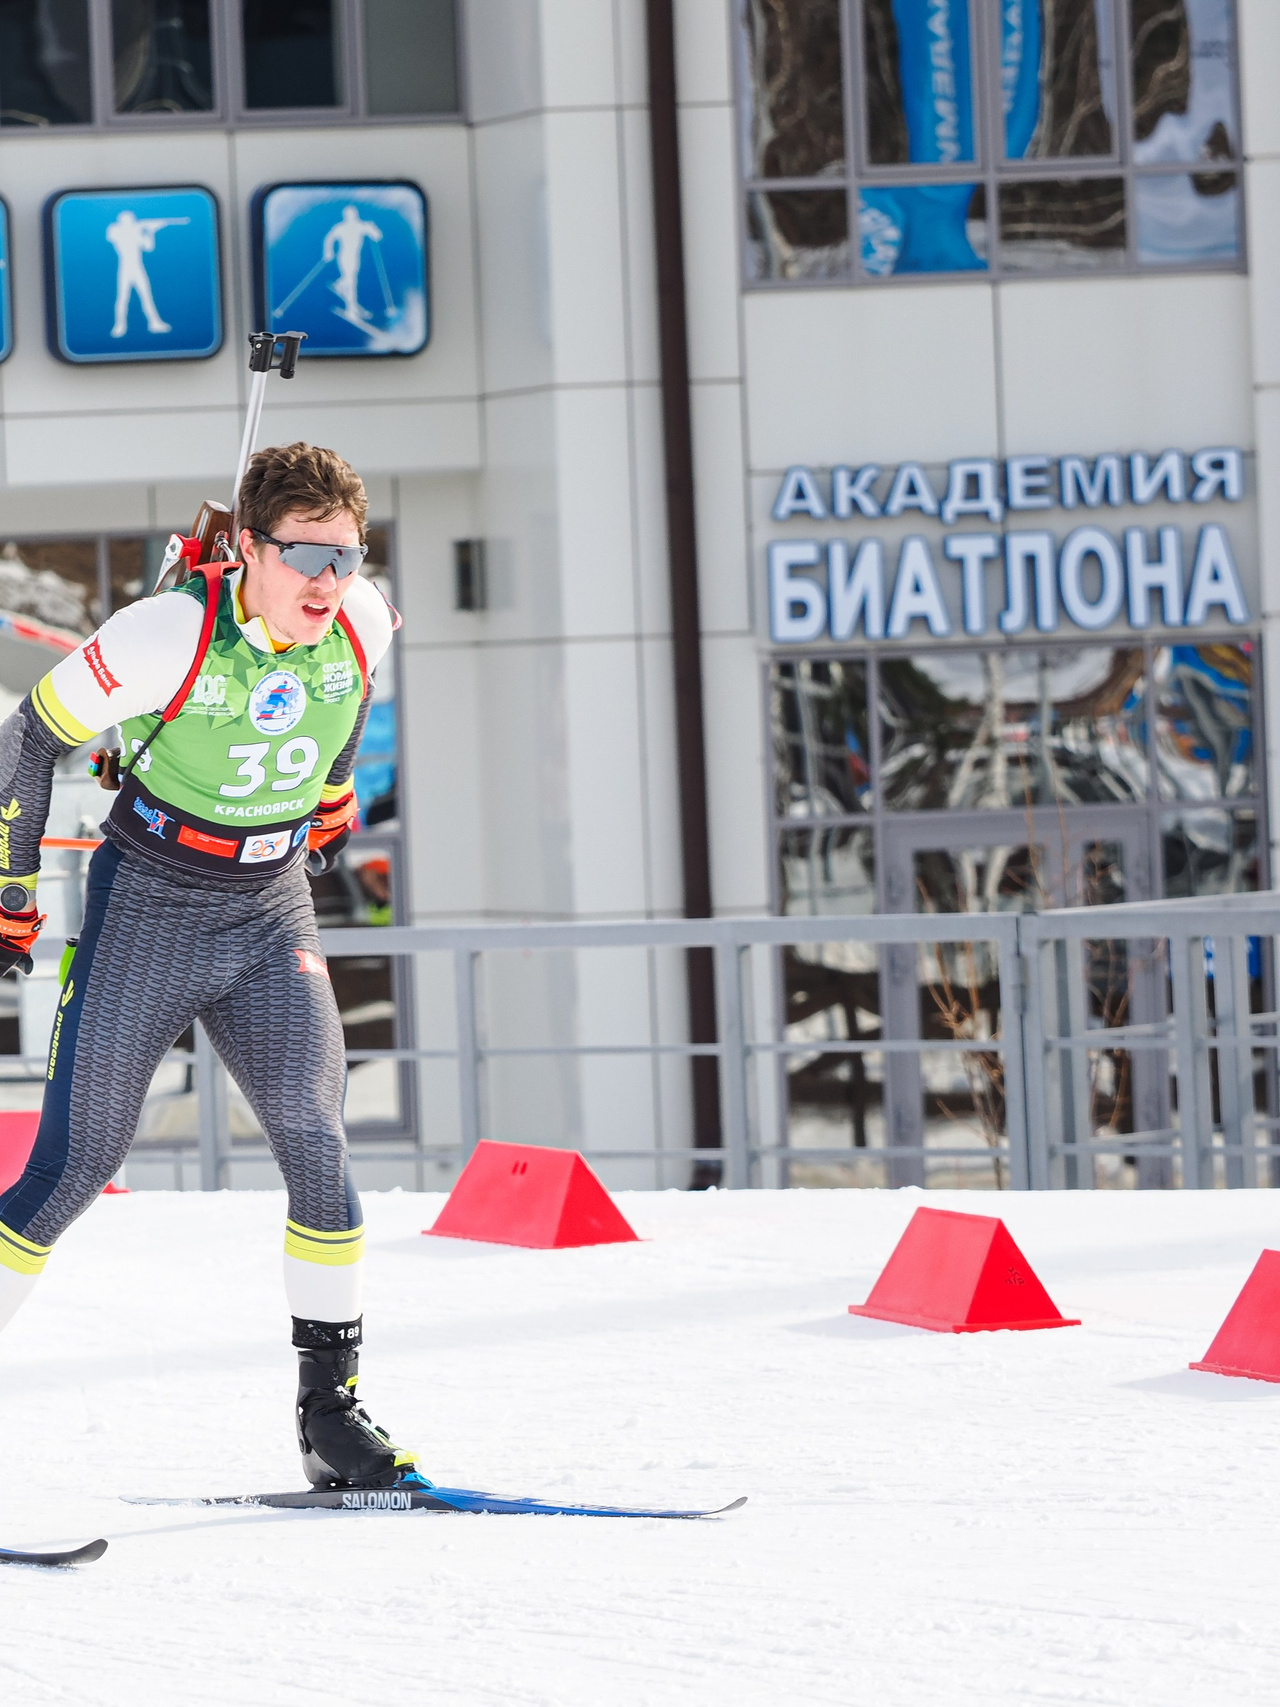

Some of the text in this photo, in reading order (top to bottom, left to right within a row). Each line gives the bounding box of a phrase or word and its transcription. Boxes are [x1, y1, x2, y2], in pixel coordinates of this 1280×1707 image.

[772, 447, 1245, 526] АКАДЕМИЯ
[767, 523, 1250, 643] БИАТЛОНА
[218, 736, 320, 798] 39
[214, 797, 306, 818] КРАСНОЯРСК
[337, 1326, 360, 1341] 189
[342, 1492, 412, 1510] SALOMON
